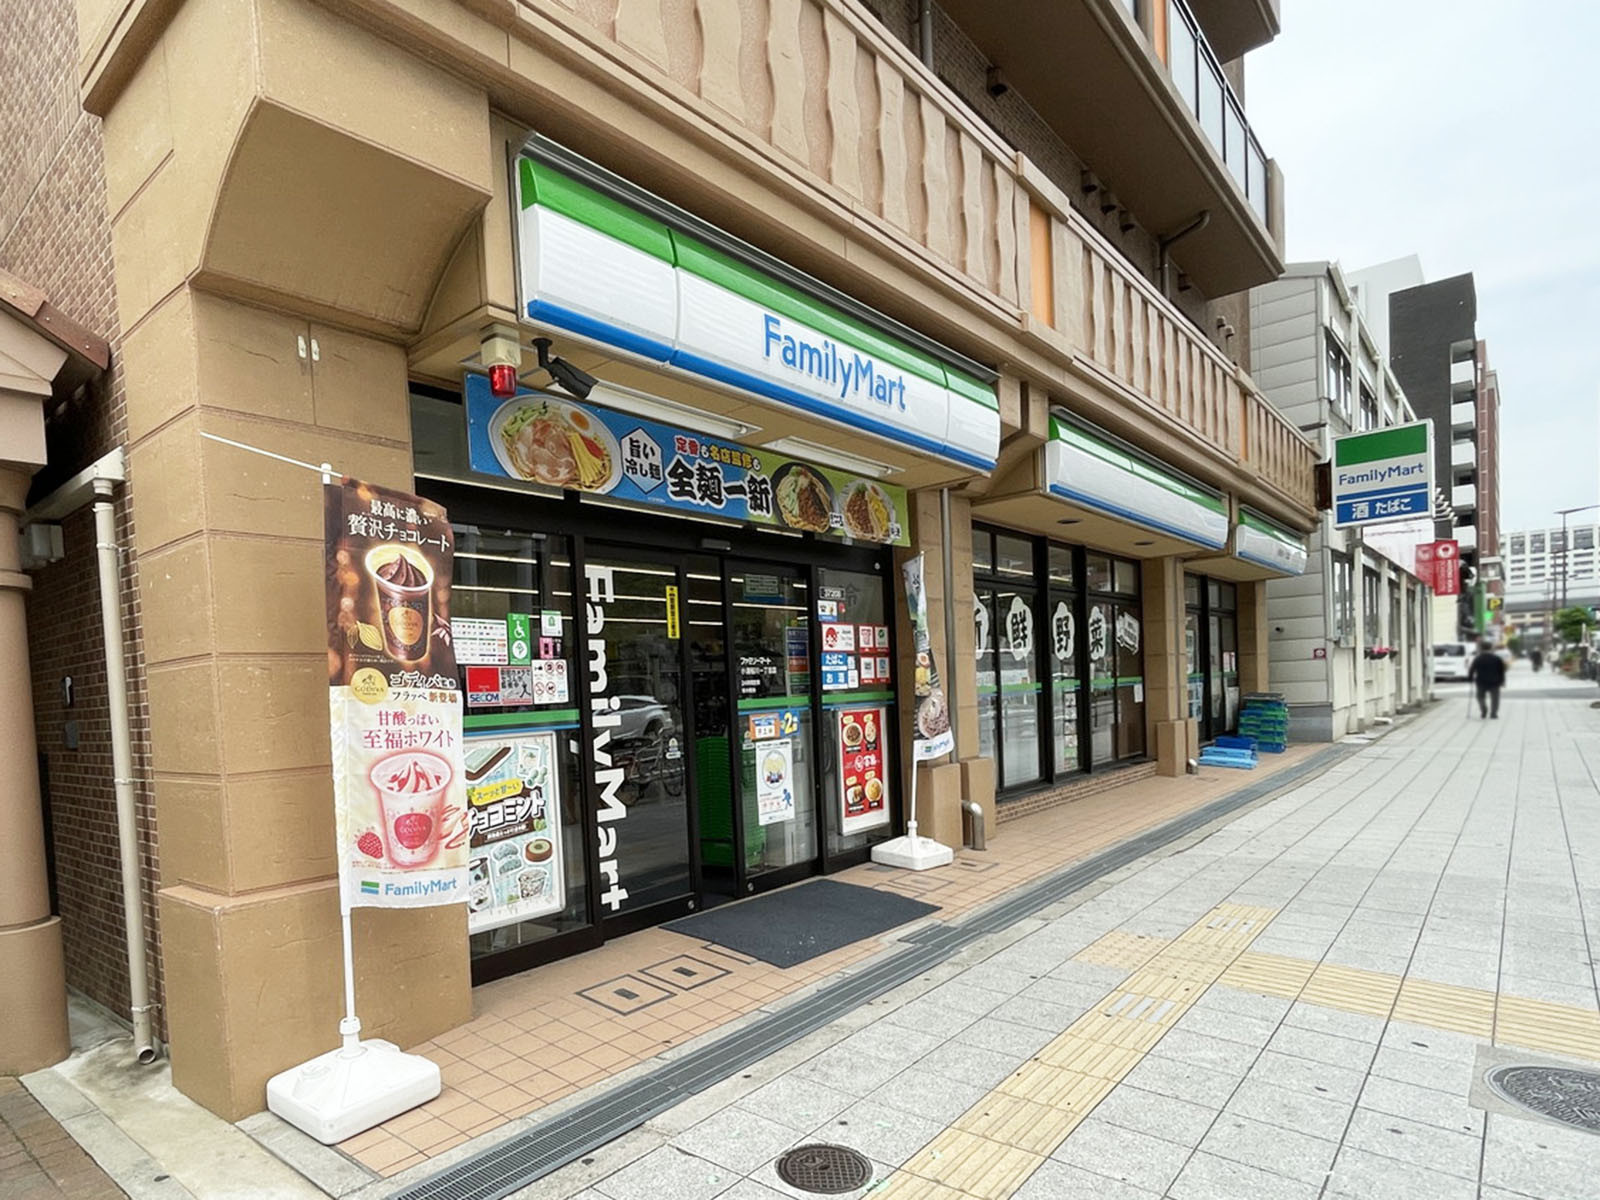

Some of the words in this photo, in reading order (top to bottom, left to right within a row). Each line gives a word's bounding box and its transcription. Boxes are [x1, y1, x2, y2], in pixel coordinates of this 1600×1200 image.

[764, 313, 907, 411] FamilyMart
[628, 437, 656, 459] 旨い
[1338, 462, 1424, 486] FamilyMart
[665, 454, 773, 517] 全麺一新
[1351, 501, 1370, 519] 酒
[1375, 497, 1412, 515] たばこ
[347, 513, 451, 553] 贅沢チョコレート
[469, 693, 500, 703] SECOM
[376, 709, 440, 726] 甘酸っぱい
[362, 729, 455, 749] 至福ホワイト
[385, 878, 457, 896] FamilyMart
